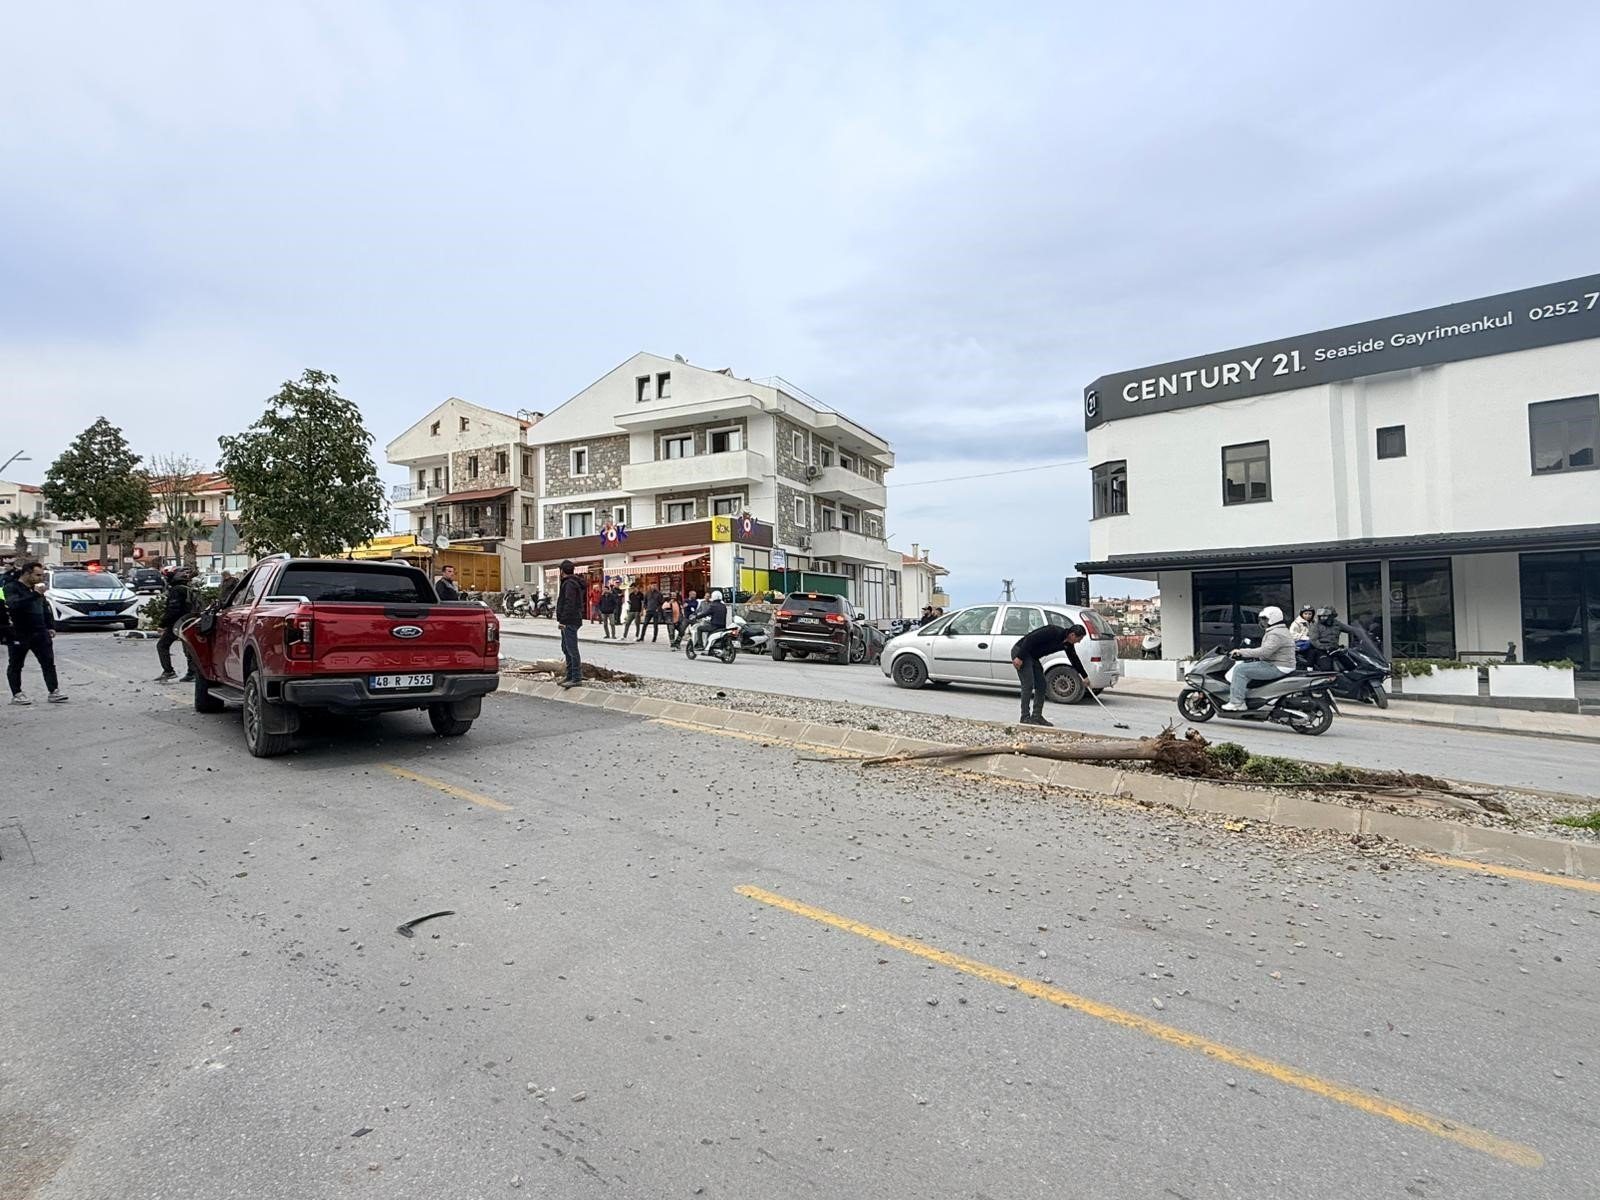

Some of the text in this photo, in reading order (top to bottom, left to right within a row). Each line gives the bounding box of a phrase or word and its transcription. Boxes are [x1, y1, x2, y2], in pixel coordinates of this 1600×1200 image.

[1122, 357, 1263, 402] CENTURY
[1314, 339, 1385, 361] Seaside
[1390, 311, 1512, 348] Gayrimenkul
[1528, 300, 1579, 321] 0252
[376, 675, 432, 687] 48 R 7525
